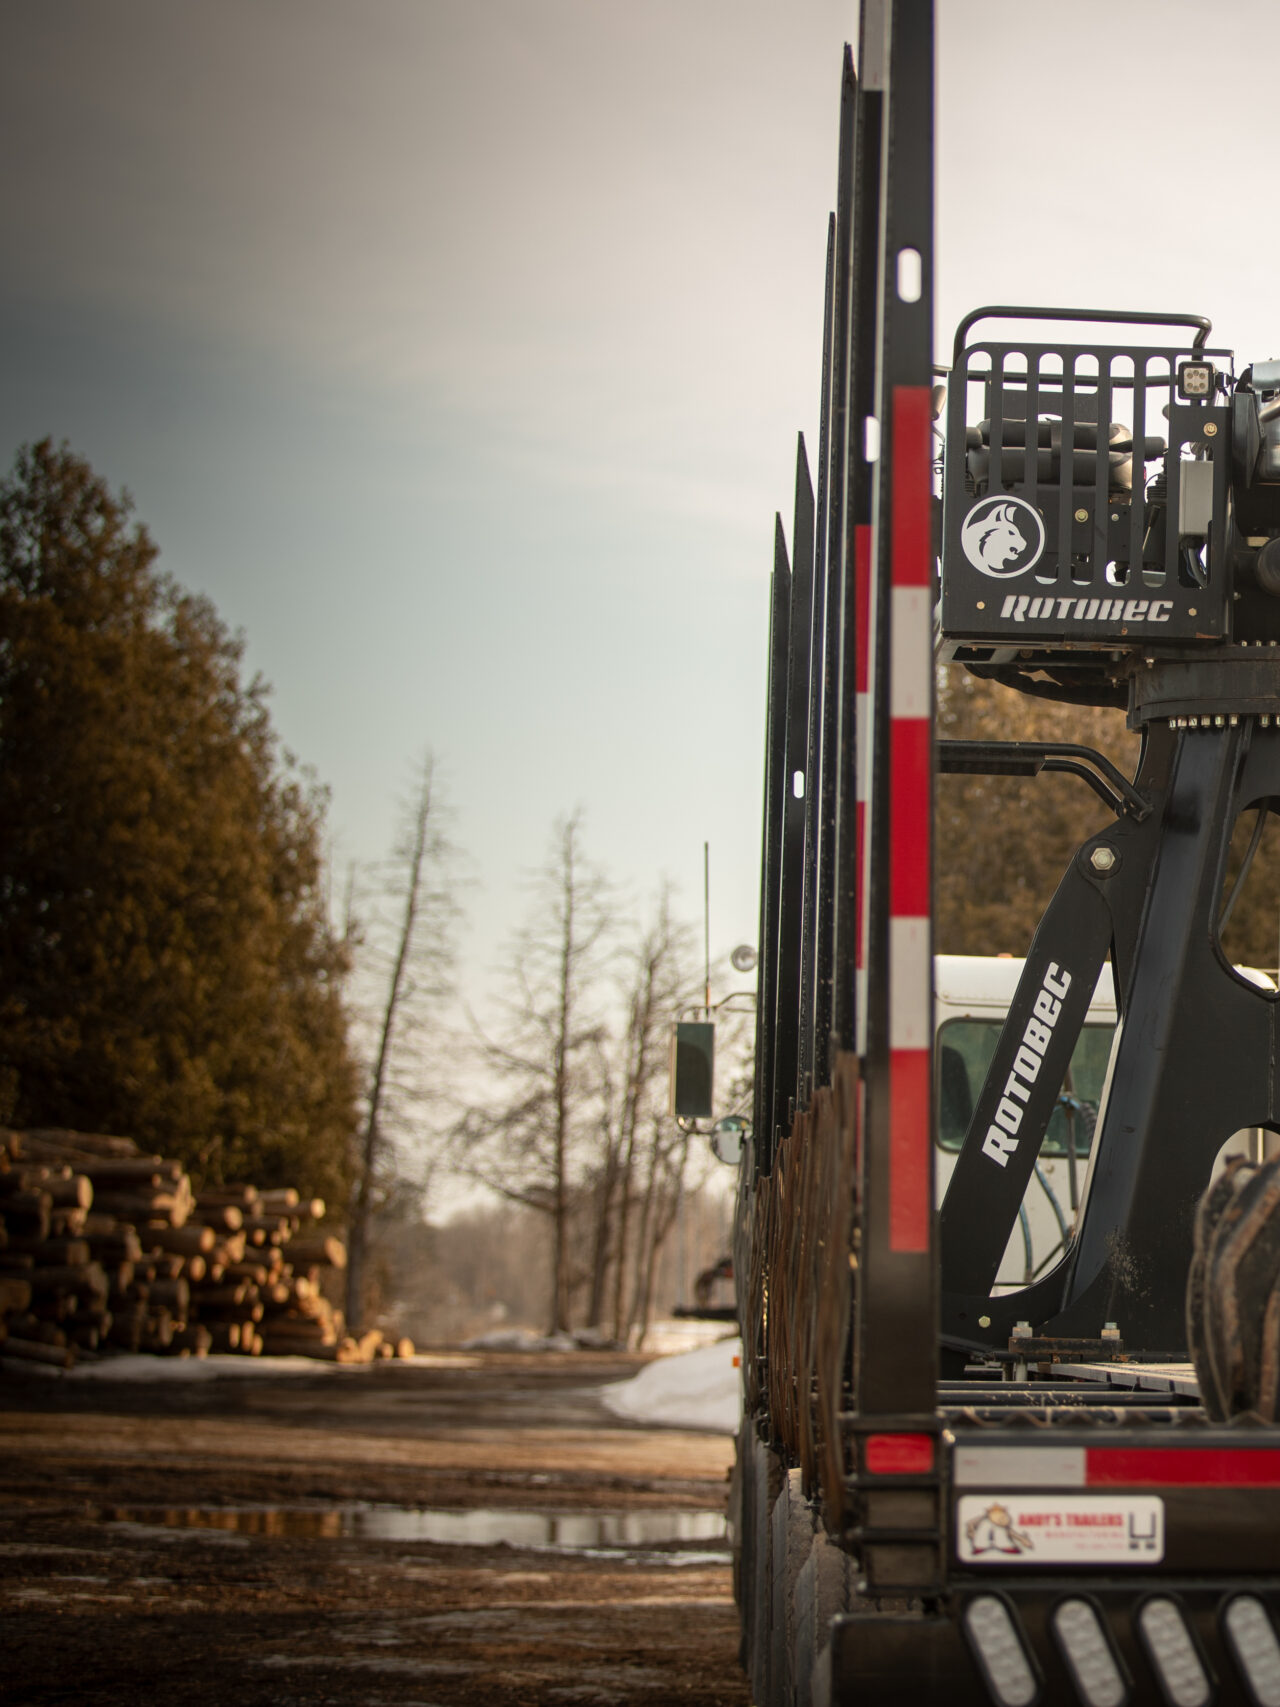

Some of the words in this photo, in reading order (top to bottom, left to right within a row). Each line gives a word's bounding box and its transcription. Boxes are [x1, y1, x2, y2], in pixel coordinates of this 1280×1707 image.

[1000, 594, 1174, 622] ROTOBEC
[982, 962, 1072, 1168] ROTOBEC
[1018, 1513, 1062, 1526] ANDY'S
[1066, 1513, 1124, 1526] TRAILERS
